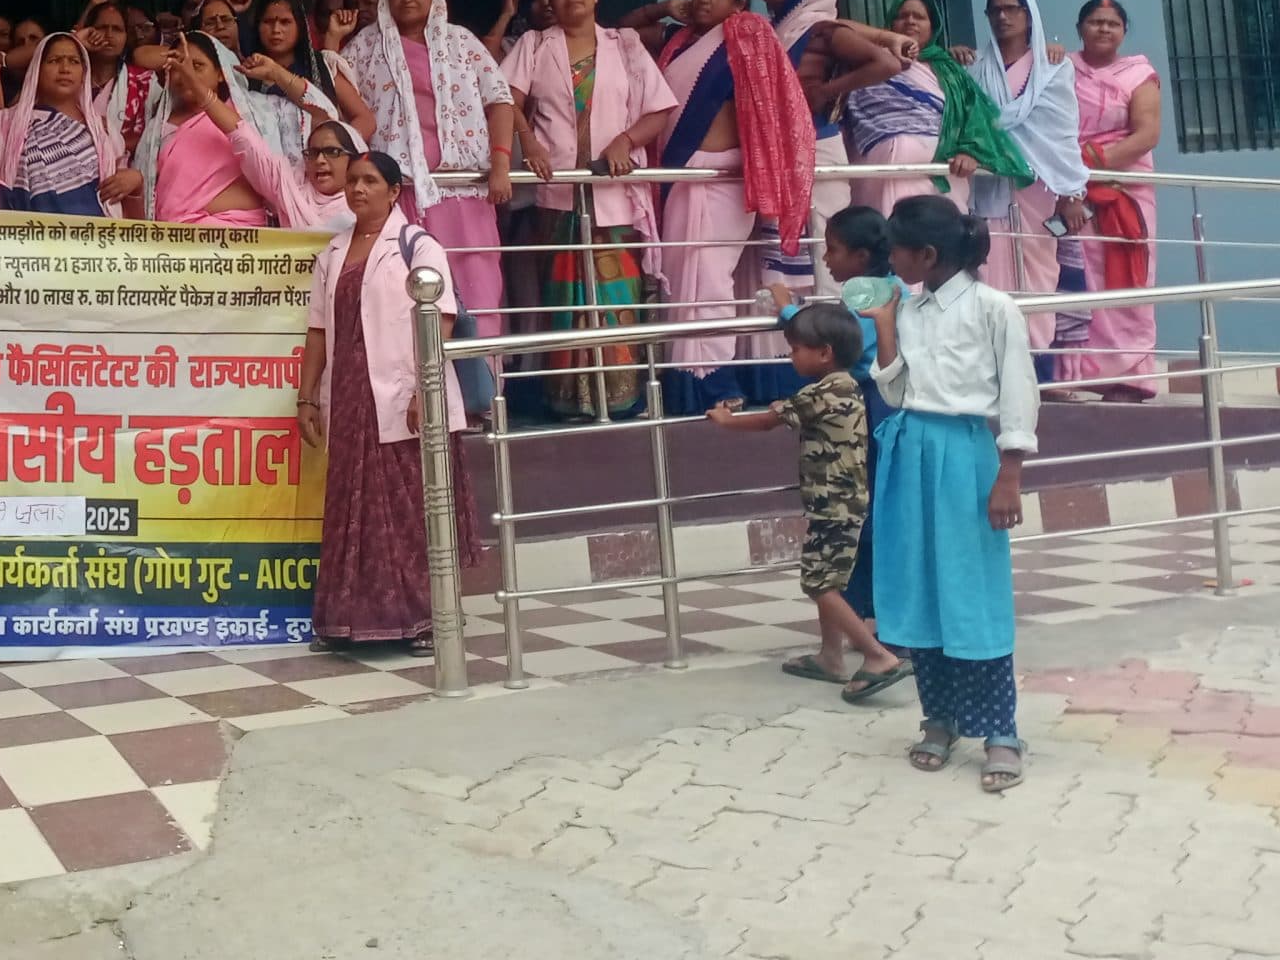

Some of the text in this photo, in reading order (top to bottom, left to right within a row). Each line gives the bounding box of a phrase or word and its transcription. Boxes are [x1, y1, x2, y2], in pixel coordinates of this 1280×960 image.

[48, 221, 67, 241] को
[69, 222, 95, 246] बढ़ी
[97, 222, 117, 249] हुई
[119, 223, 148, 243] राशि
[151, 224, 165, 243] के
[167, 227, 196, 244] साथ
[198, 229, 228, 249] लागू
[4, 256, 51, 279] न्यूनतम
[54, 257, 68, 273] 21
[70, 257, 104, 275] हजार
[124, 253, 139, 273] के
[141, 253, 186, 275] मासिक
[189, 252, 234, 276] मानदेय
[236, 253, 255, 275] की
[257, 254, 293, 276] गारंटी
[24, 289, 40, 304] 10
[42, 289, 75, 306] लाख
[95, 290, 115, 306] का
[117, 284, 177, 307] रिटायरमेंट
[180, 284, 215, 307] पैकेज
[217, 291, 228, 306] व
[230, 286, 281, 307] आजीवन
[6, 343, 142, 388] फैसिलिटेटर
[144, 345, 178, 388] की
[128, 414, 301, 504] हड़ताल
[85, 506, 131, 532] 2025
[83, 548, 128, 590] संघ
[133, 547, 193, 595] (गोप
[196, 558, 233, 604] गुट
[12, 608, 99, 637] कार्यकर्ता
[104, 609, 139, 637] संघ
[143, 616, 210, 640] प्रखण्ड
[284, 617, 317, 643] दुग
